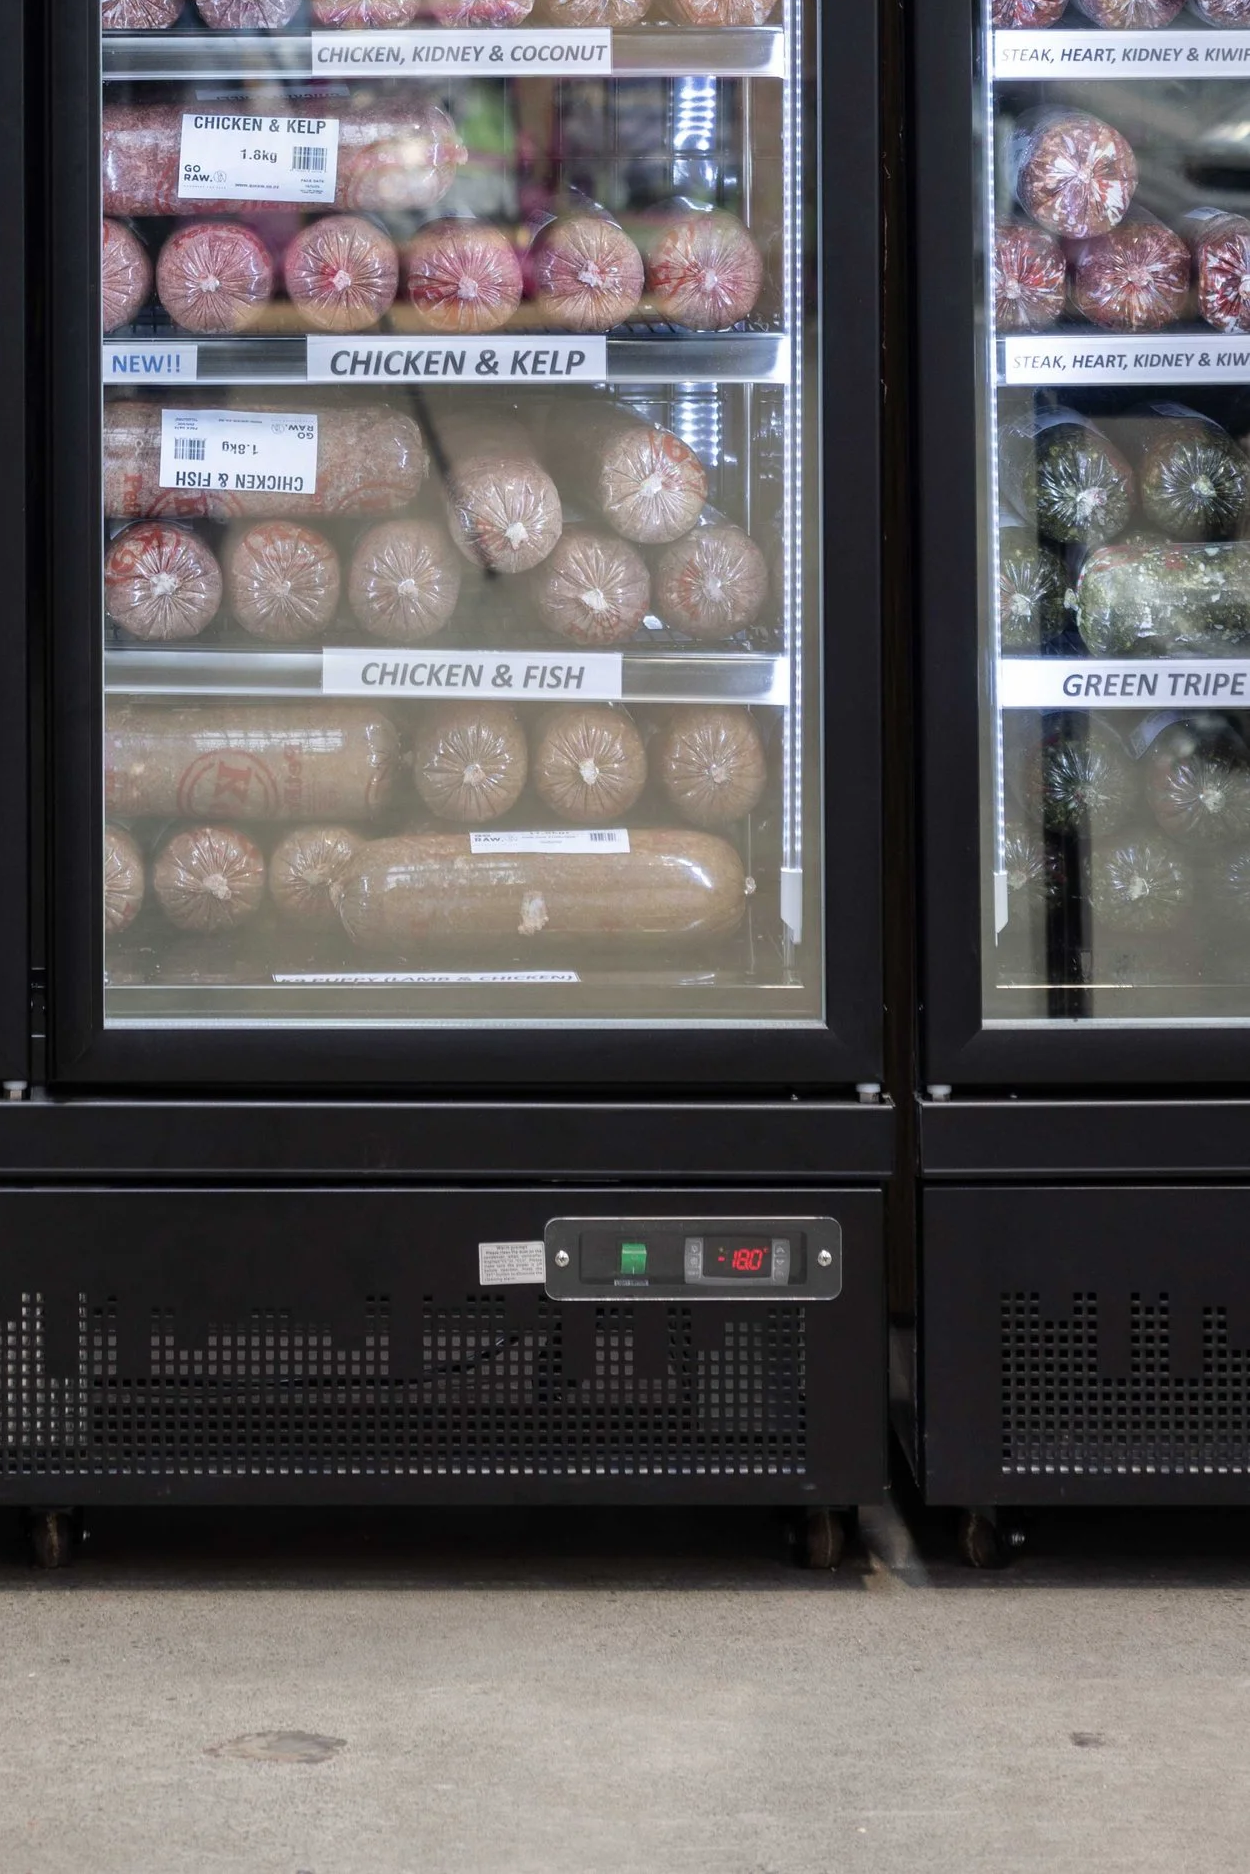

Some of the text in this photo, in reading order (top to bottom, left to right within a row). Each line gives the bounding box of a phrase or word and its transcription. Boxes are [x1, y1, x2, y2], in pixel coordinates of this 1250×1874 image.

[317, 44, 607, 66] CHICKEN, KIDNEY & COCONUT
[1002, 47, 1057, 65] STEAK,
[1060, 48, 1116, 65] HEART,
[1121, 47, 1183, 62] KIDNEY
[1187, 47, 1199, 62] &
[194, 116, 326, 134] CHICKEN & KELP
[240, 149, 278, 163] 1.8kg
[184, 164, 201, 172] GO
[184, 174, 212, 182] RAW.
[111, 355, 181, 374] NEW!!
[330, 350, 585, 376] CHICKEN & KELP
[1012, 355, 1068, 372] STEAK,
[1073, 354, 1128, 372] HEART,
[1133, 354, 1195, 370] KIDNEY
[1199, 353, 1211, 369] &
[222, 442, 258, 455] 1.8kg
[176, 472, 303, 491] CHICKEN & FISH
[361, 663, 585, 689] CHICKEN & FISH
[1062, 672, 1246, 697] GREEN TRIPE
